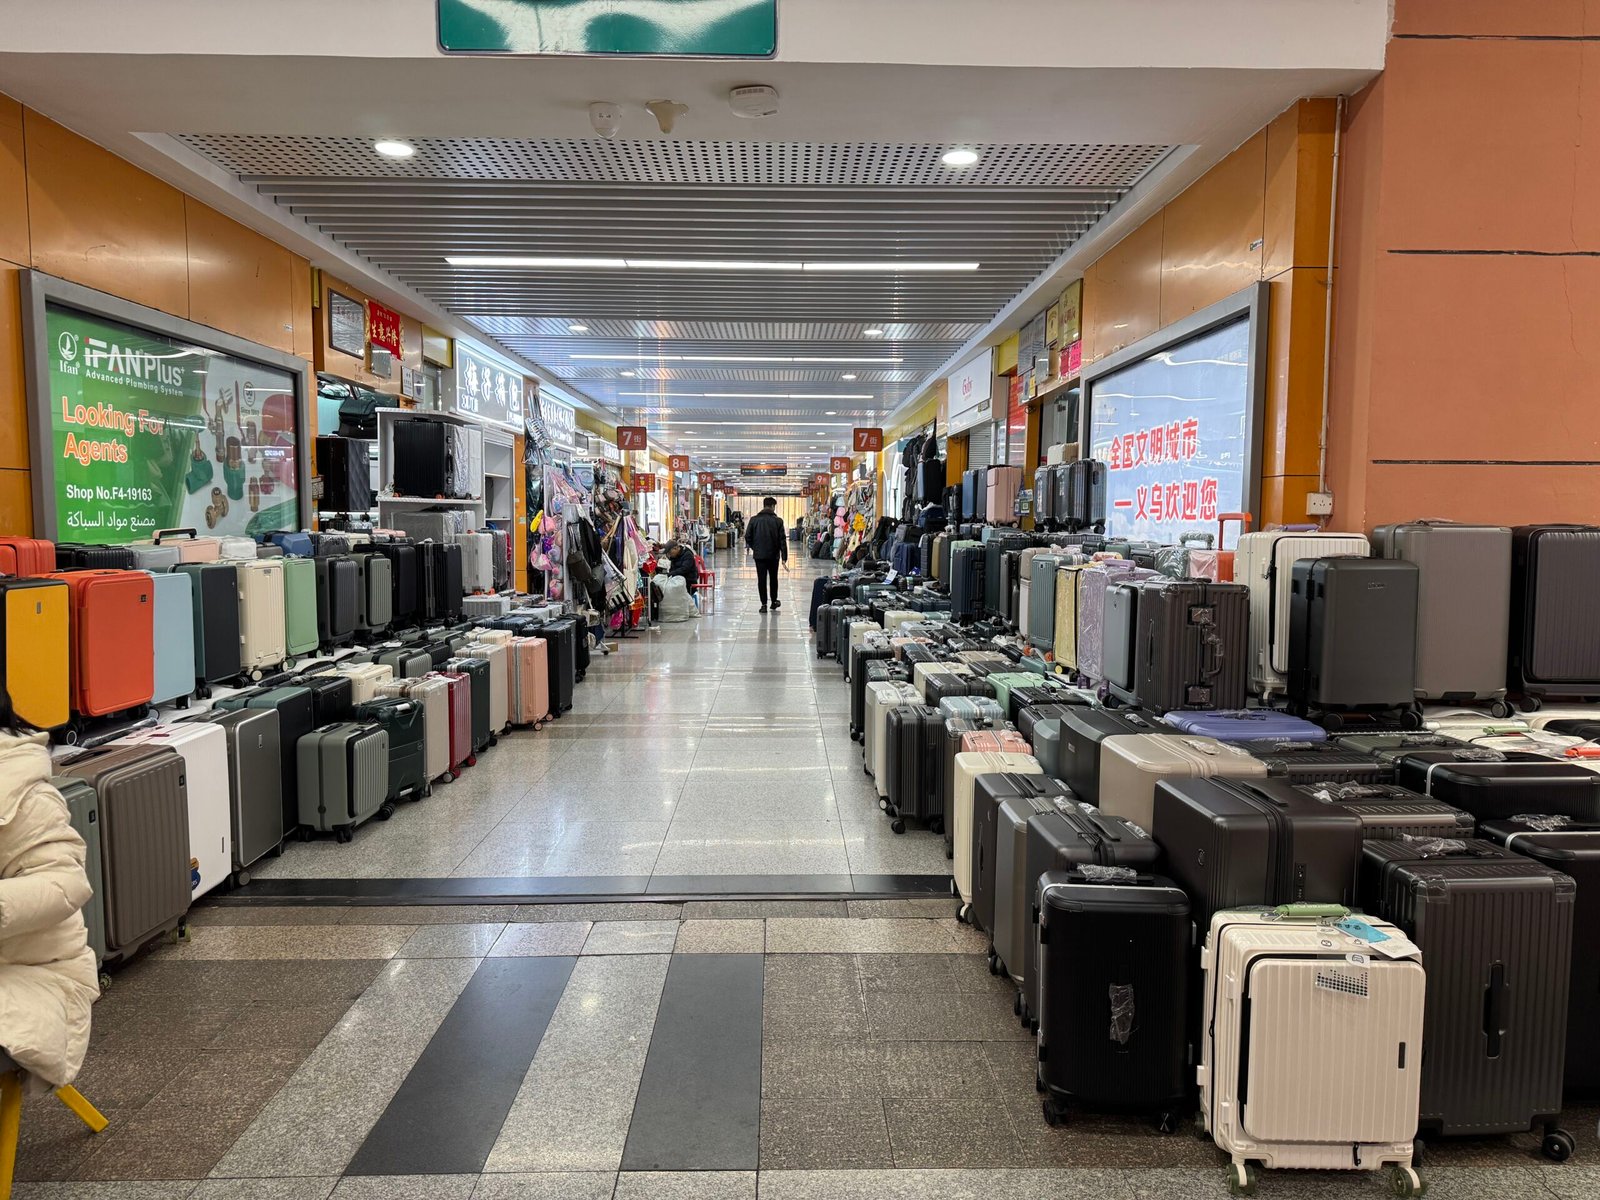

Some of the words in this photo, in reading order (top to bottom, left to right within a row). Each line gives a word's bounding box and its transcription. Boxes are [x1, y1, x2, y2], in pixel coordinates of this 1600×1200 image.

[86, 369, 123, 385] Advanced
[126, 379, 158, 394] Plumbing
[160, 385, 183, 397] System
[62, 396, 135, 437] Looking
[138, 408, 165, 435] For
[63, 432, 128, 466] Agents
[1109, 418, 1199, 471] 全国文明城市
[66, 484, 94, 502] Shop
[96, 486, 153, 501] No.F4-19163
[67, 510, 104, 529] السباكة
[106, 511, 128, 530] مواد
[130, 515, 156, 532] مصنع
